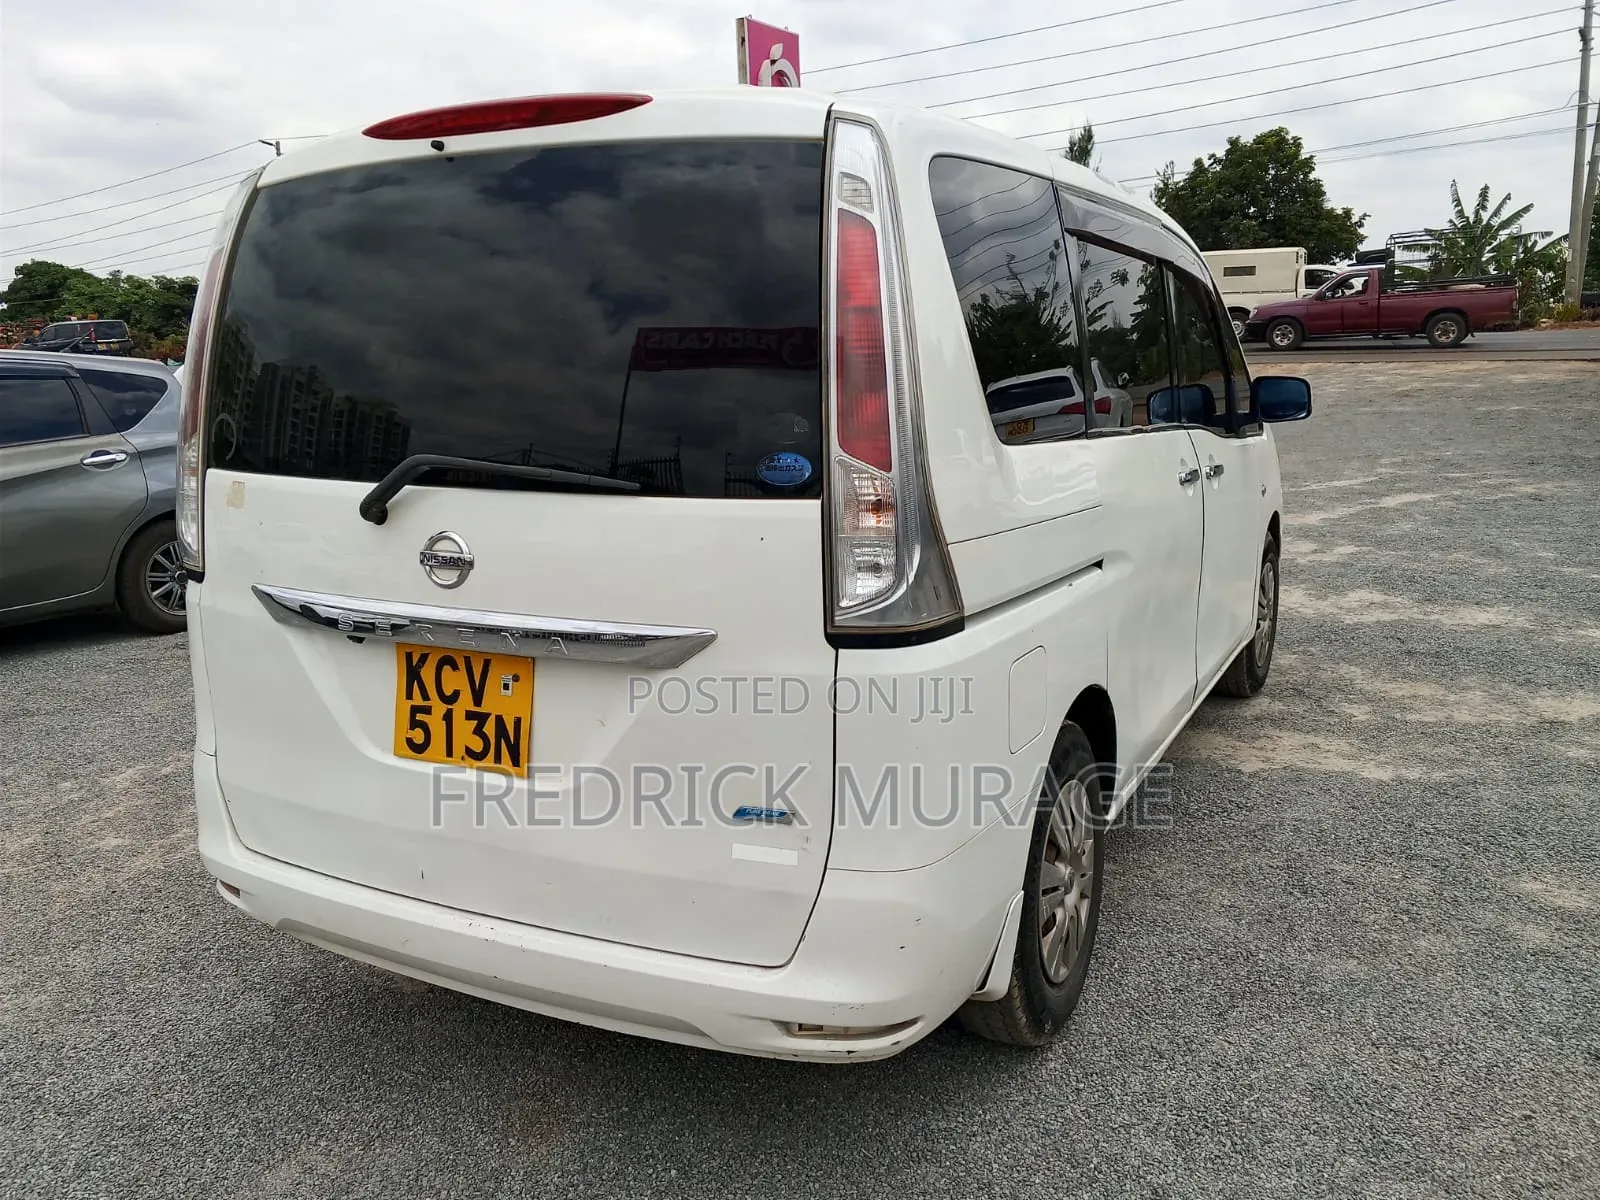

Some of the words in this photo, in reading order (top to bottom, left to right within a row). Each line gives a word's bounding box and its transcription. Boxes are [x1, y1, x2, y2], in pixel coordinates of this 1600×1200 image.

[422, 552, 466, 567] NISSAN
[338, 612, 569, 656] SERENA
[405, 652, 492, 708] KCV
[405, 704, 522, 768] 513N
